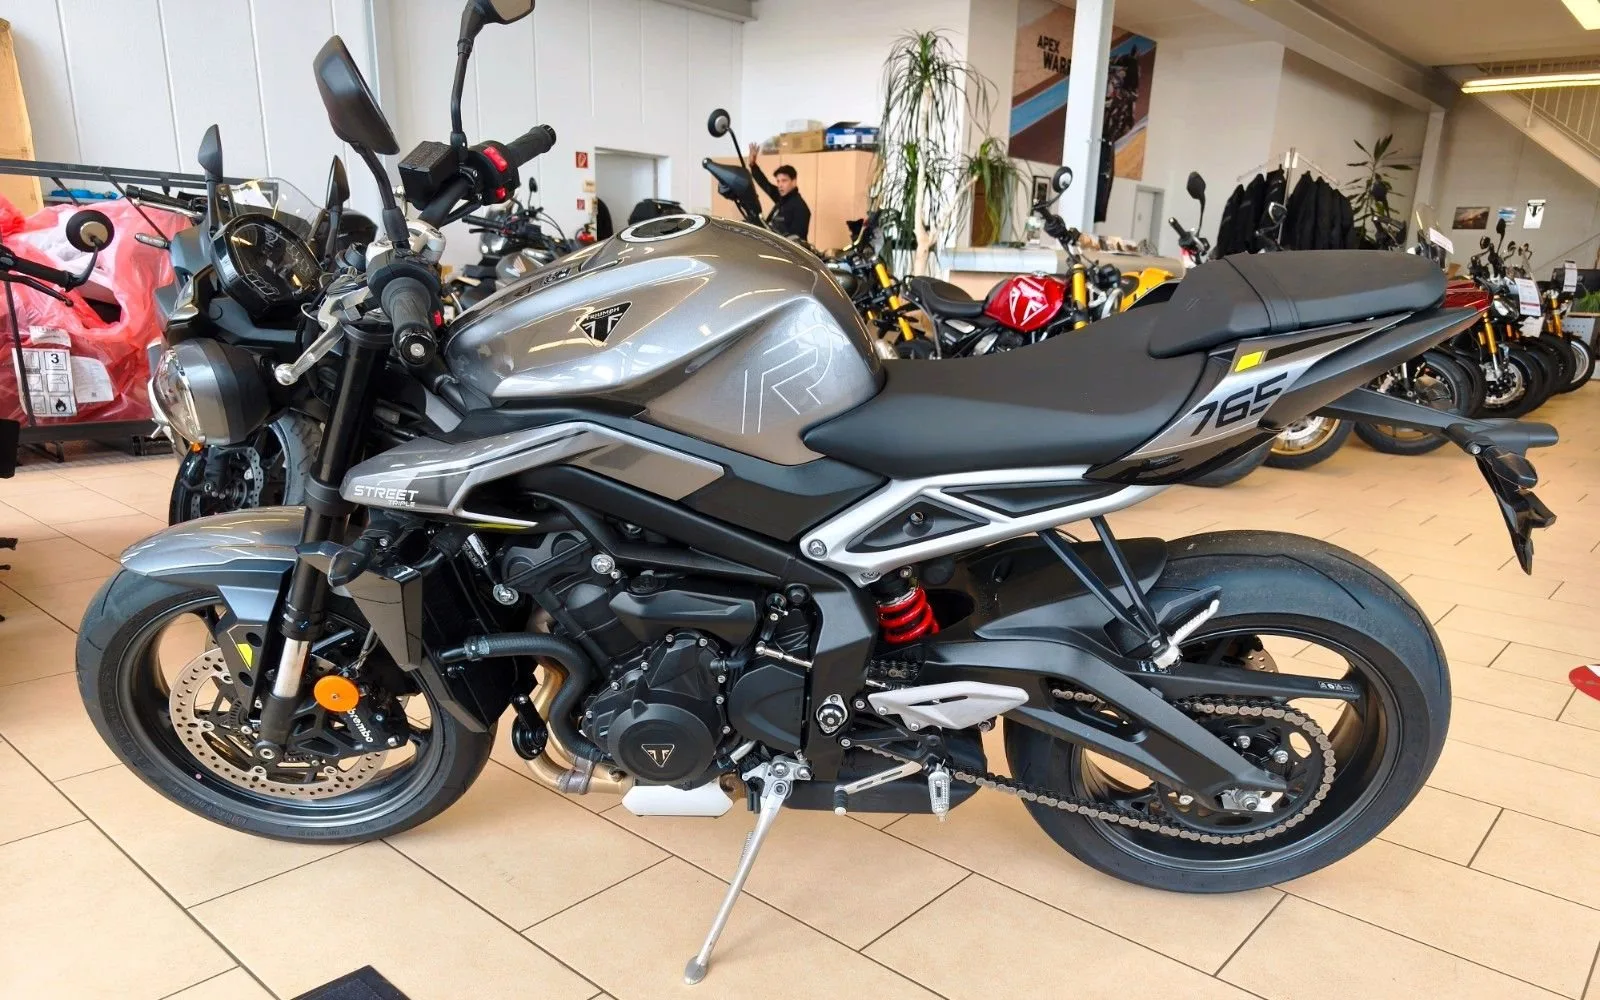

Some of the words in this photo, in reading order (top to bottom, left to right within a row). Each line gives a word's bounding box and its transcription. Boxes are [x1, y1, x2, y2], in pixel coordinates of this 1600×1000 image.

[1037, 35, 1060, 54] APEX
[586, 306, 620, 320] TRIUMPH
[51, 353, 60, 364] 3
[1190, 371, 1288, 437] 765
[353, 485, 419, 501] STREET
[388, 500, 416, 508] TRIPLE
[347, 707, 374, 743] brembo
